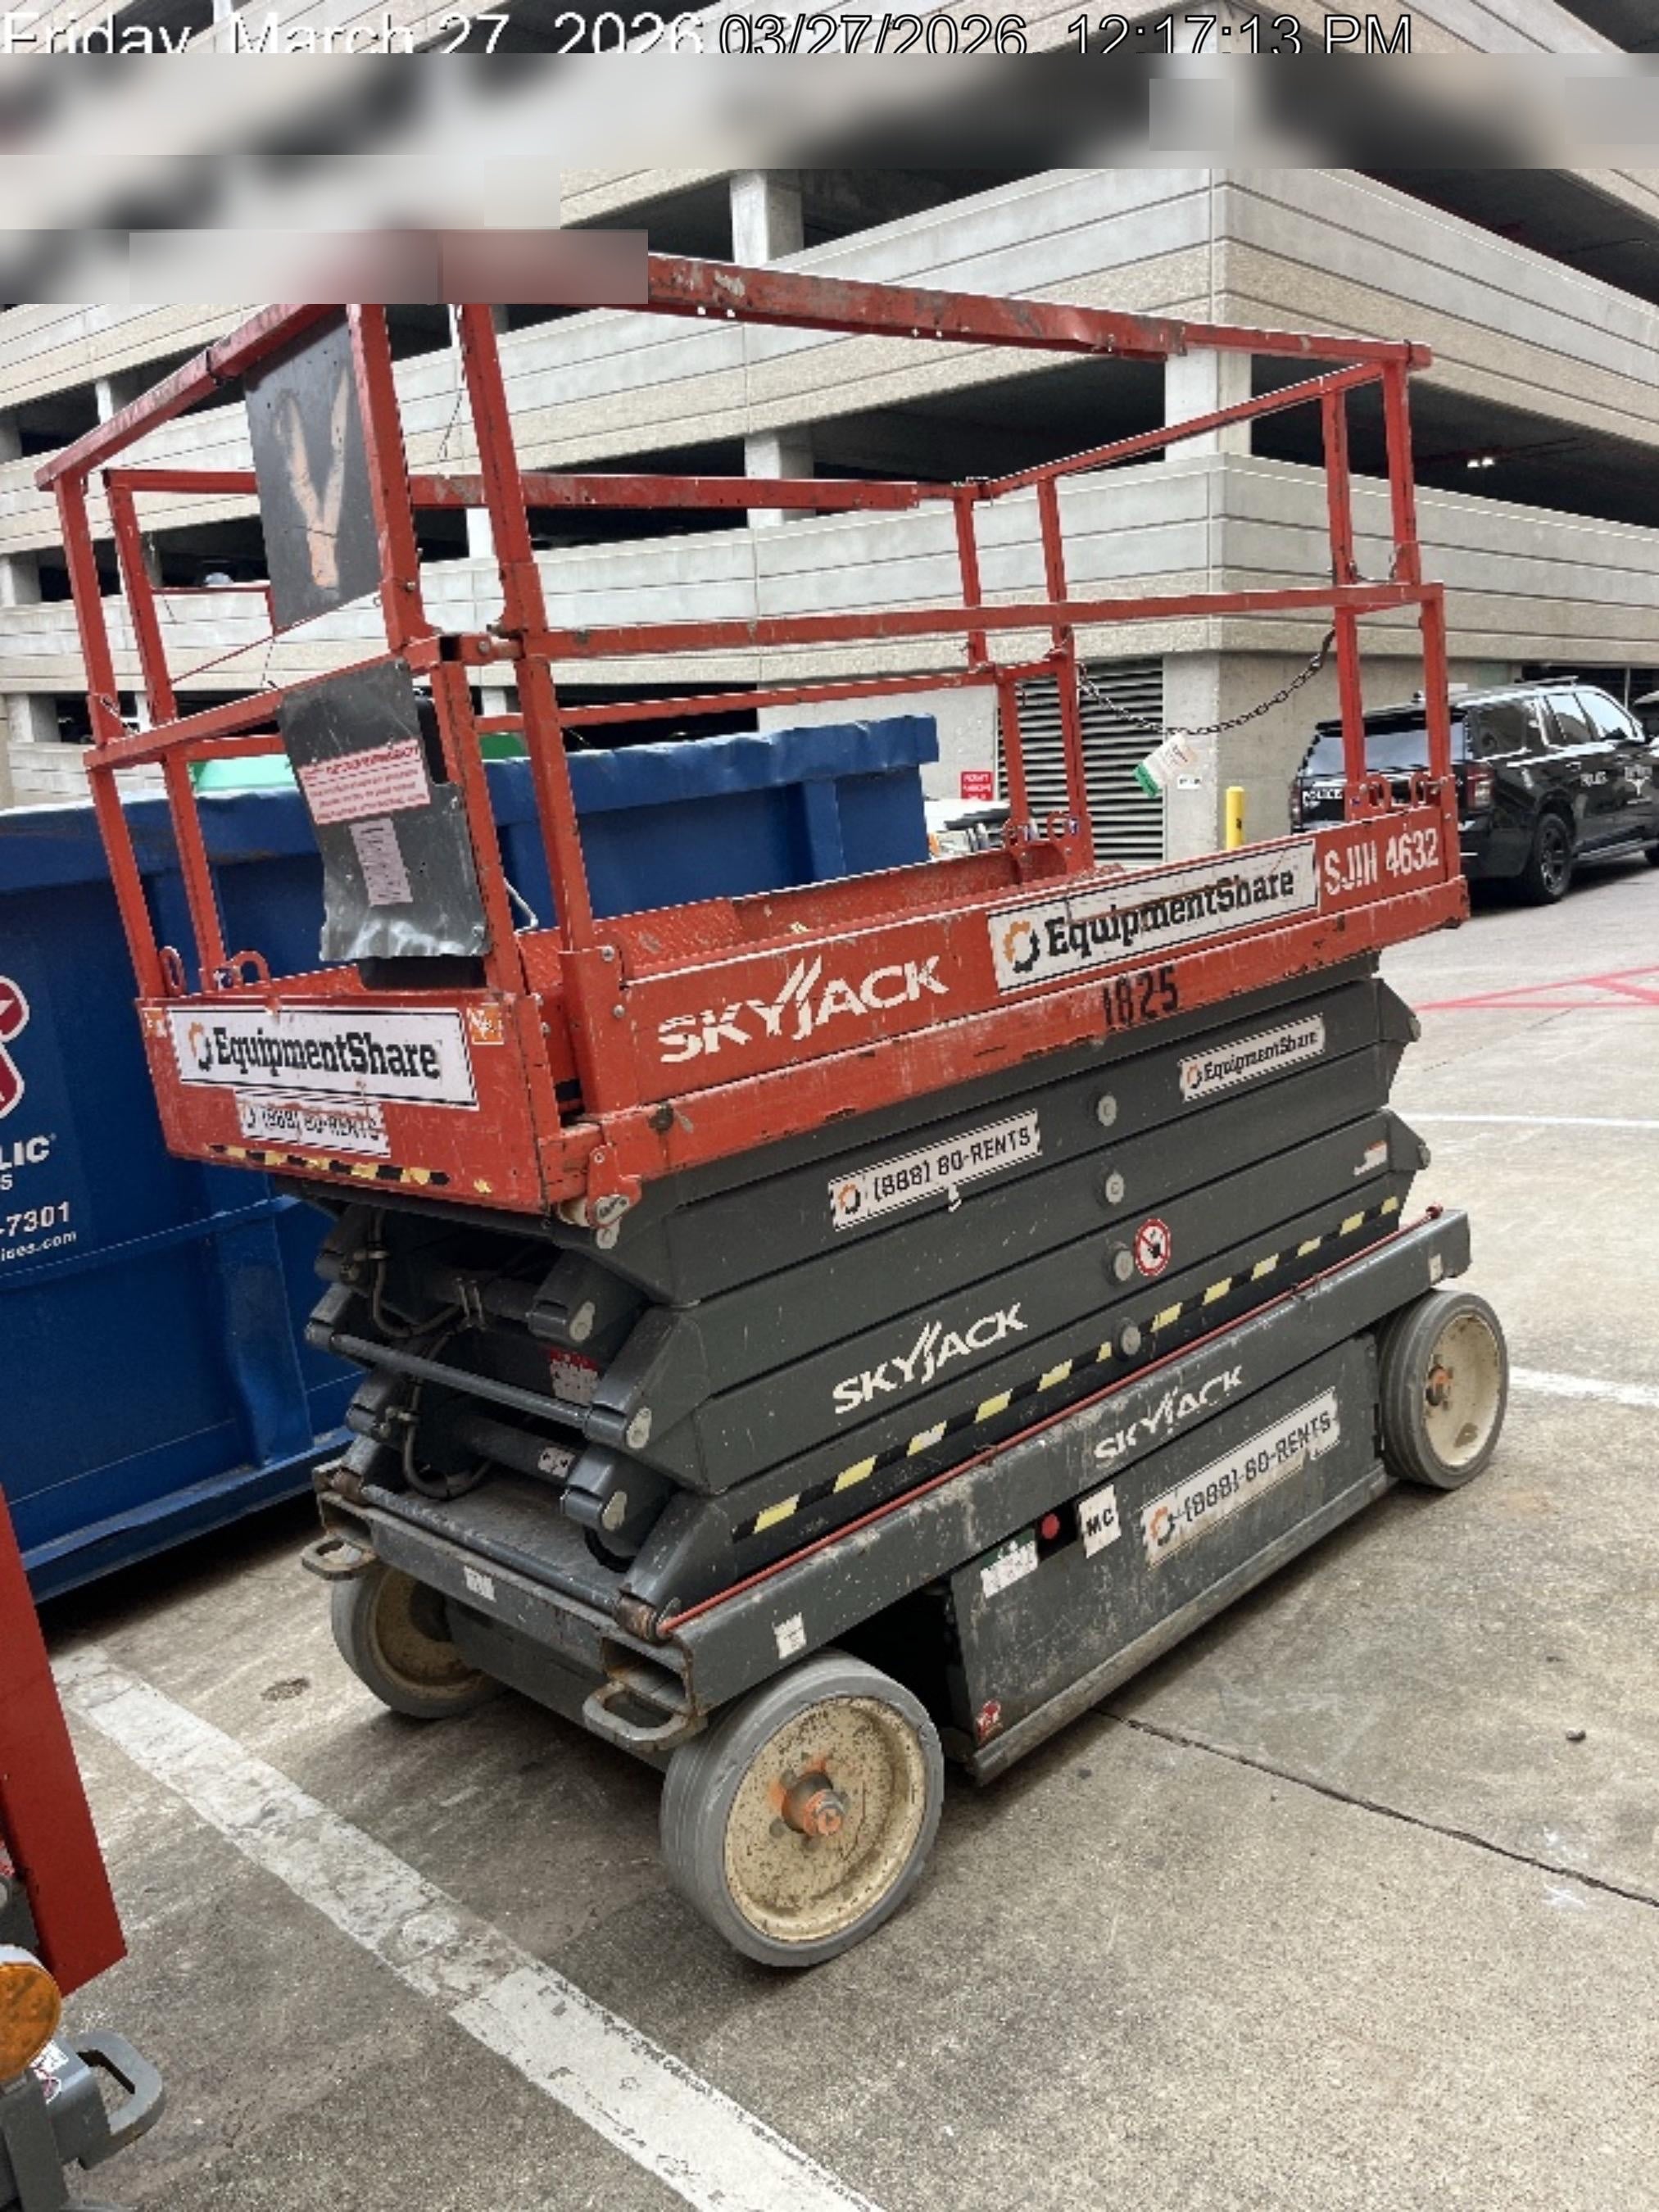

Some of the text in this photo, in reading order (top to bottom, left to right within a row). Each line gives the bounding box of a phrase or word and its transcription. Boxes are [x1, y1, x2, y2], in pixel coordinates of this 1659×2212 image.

[1386, 827, 1439, 878] 4632
[1045, 870, 1294, 959] EquipmentShare
[658, 954, 950, 1064] SKYJACK
[1102, 964, 1179, 1027] 1825
[213, 1027, 440, 1079] EquipmentShare
[1203, 1030, 1318, 1081] EquipmentShare
[873, 1126, 1031, 1202] (888) 80-RENTS
[832, 1302, 1028, 1414] SKYJACK
[1094, 1365, 1243, 1465] SKYJACK
[1086, 1507, 1115, 1537] MC
[1183, 1468, 1240, 1522] (888)
